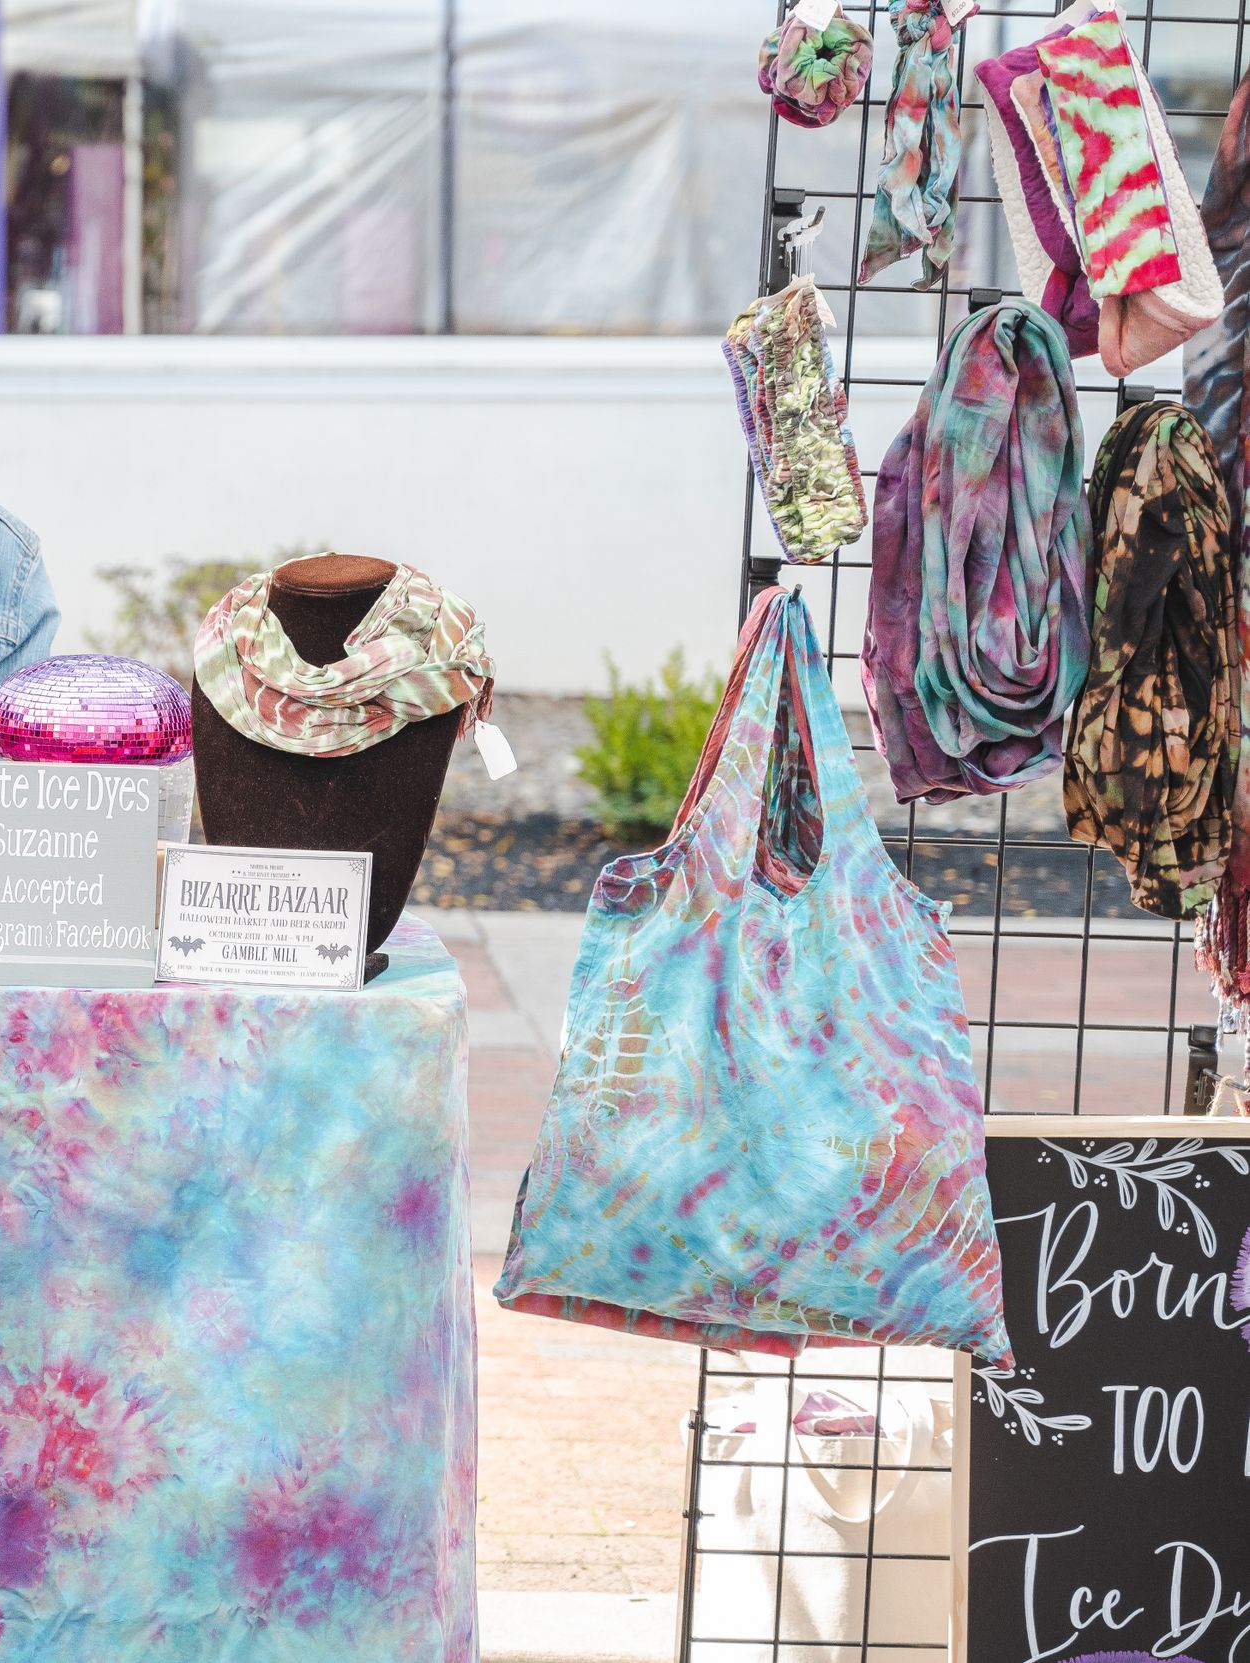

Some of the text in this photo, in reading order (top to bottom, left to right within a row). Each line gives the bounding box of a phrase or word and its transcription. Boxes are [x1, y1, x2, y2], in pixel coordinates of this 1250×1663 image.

[36, 769, 80, 810] Ice
[86, 771, 150, 819] Dyes
[0, 873, 104, 914] Accepted
[181, 879, 349, 919] BIZARRE BAZAAR
[56, 919, 152, 950] Facebook
[179, 913, 346, 930] HALLOWEEN MARKET AND BEER GARDEN
[209, 930, 243, 940] OCTOBER
[222, 944, 298, 963] GAMBLE MILL
[994, 1200, 1250, 1349] Born
[1102, 1386, 1204, 1474] TOO
[968, 1525, 1145, 1663] Ice
